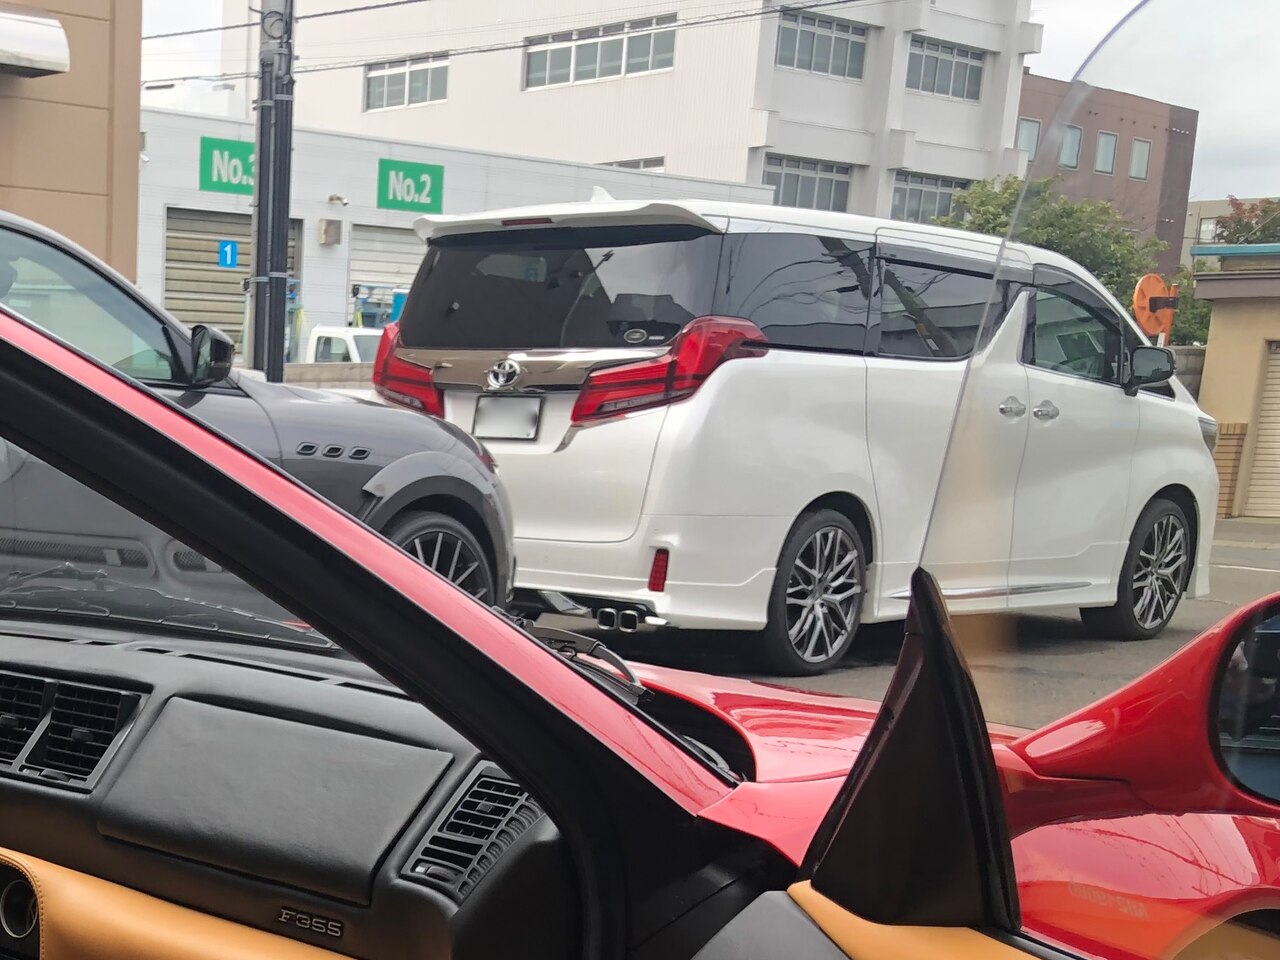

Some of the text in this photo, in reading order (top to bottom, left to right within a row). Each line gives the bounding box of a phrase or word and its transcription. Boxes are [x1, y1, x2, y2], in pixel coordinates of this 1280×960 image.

[388, 170, 432, 204] No.2
[224, 244, 232, 265] 1
[278, 909, 342, 937] F355
